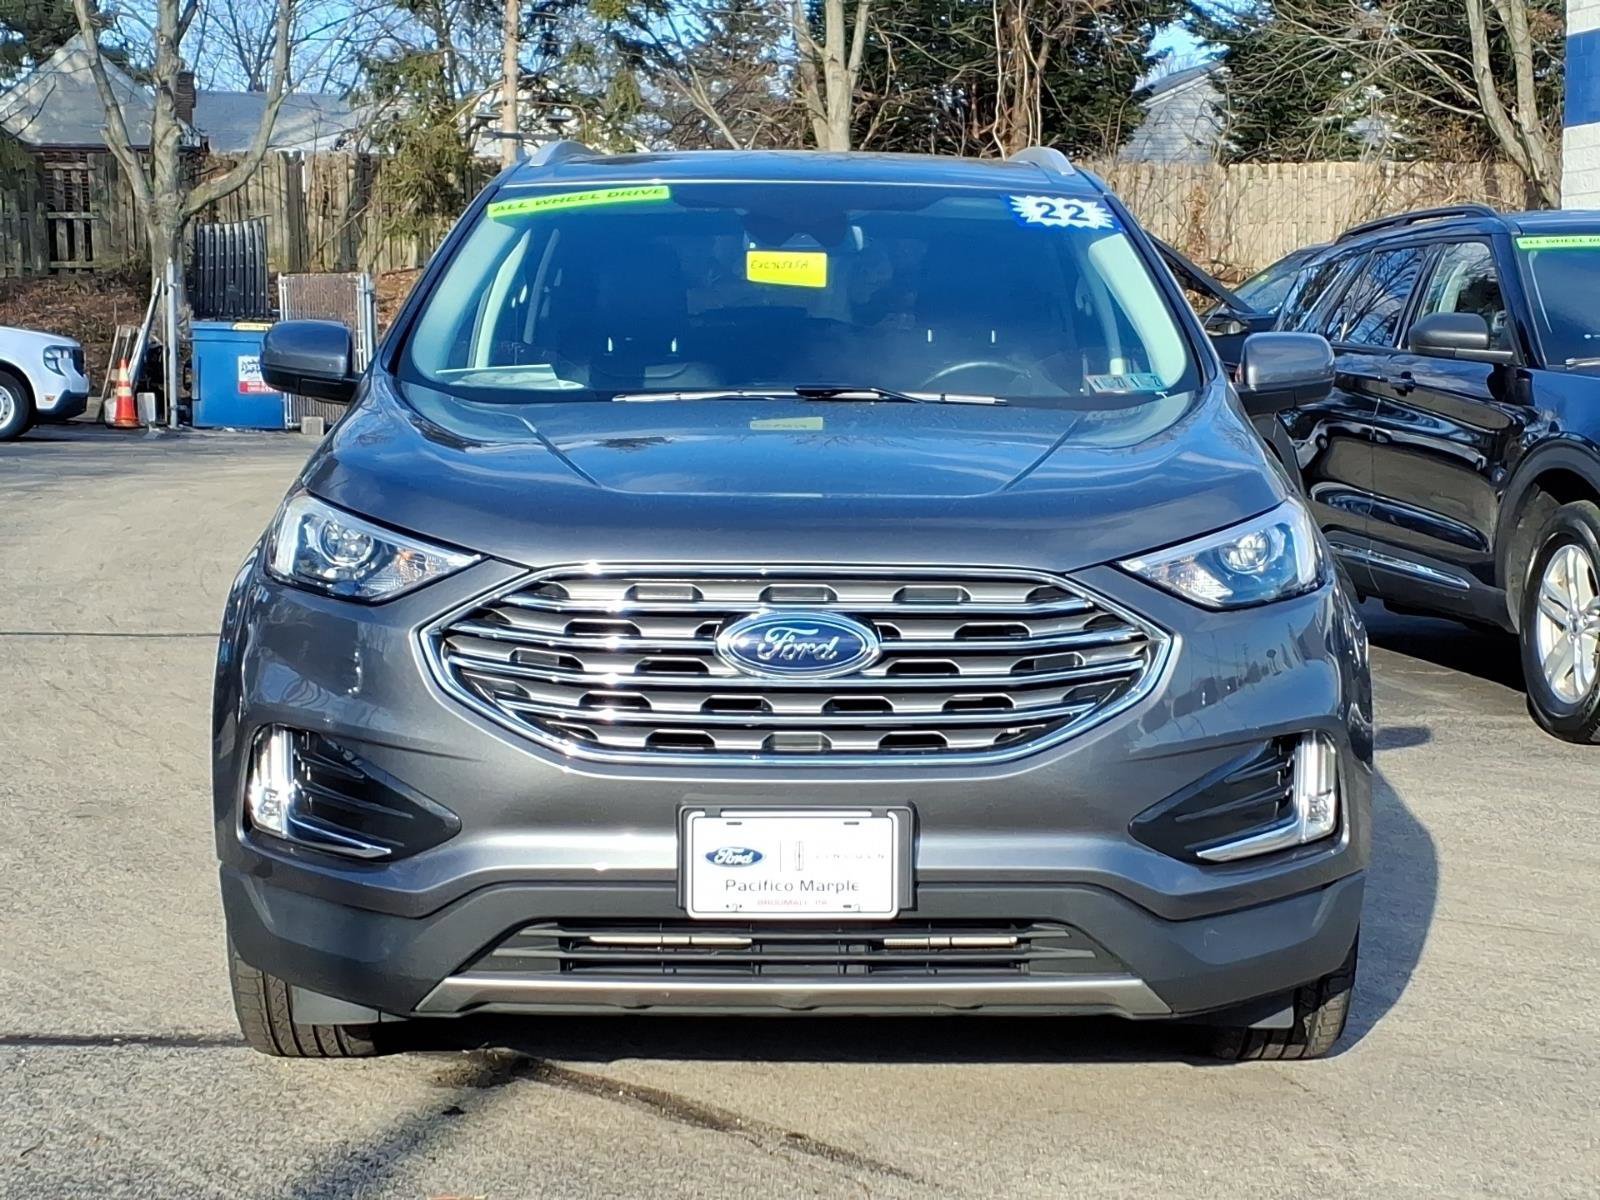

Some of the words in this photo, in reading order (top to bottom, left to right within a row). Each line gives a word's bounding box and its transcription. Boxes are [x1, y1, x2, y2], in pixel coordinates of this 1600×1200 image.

[493, 202, 528, 213] ALL
[535, 193, 601, 206] WHEEL
[607, 188, 666, 198] DRIVE
[1034, 201, 1090, 222] 22
[757, 626, 840, 661] Ford
[713, 847, 754, 865] Ford
[725, 879, 794, 892] Pacifico
[799, 879, 861, 894] Marple
